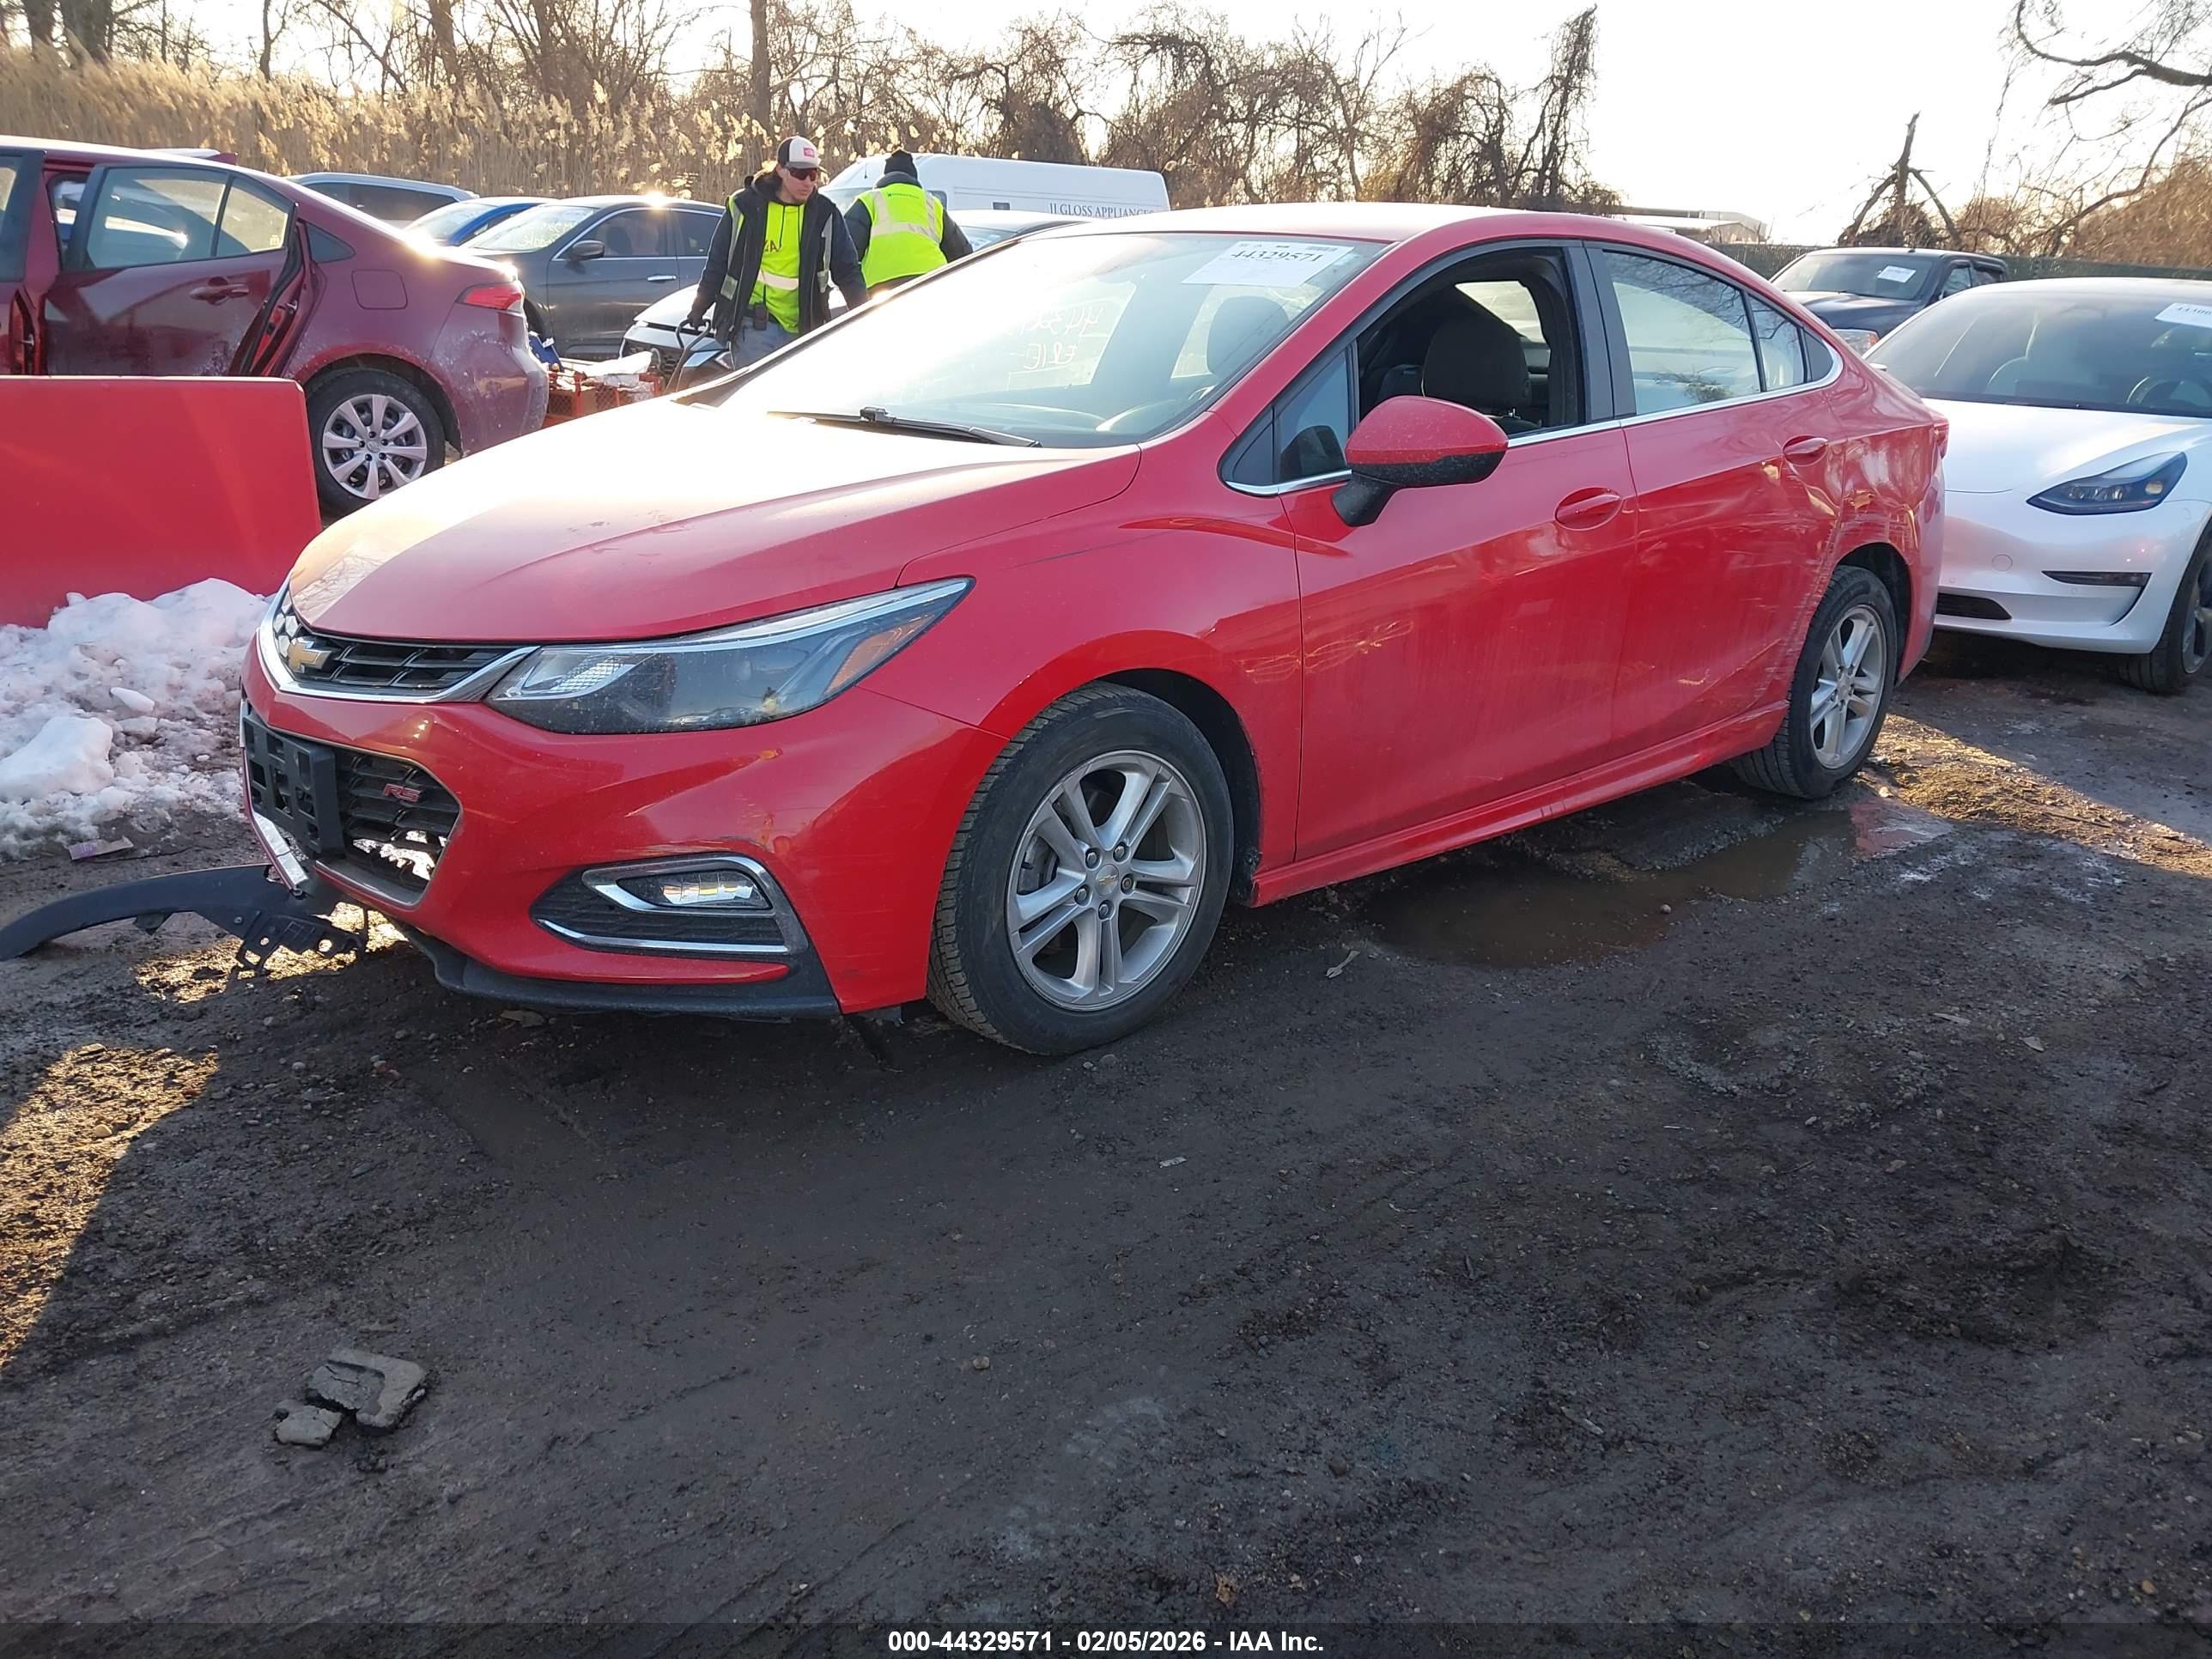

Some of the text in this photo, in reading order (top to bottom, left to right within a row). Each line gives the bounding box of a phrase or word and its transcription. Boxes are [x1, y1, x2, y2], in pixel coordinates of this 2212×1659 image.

[1060, 203, 1093, 217] GLOSS
[1231, 250, 1324, 262] 44329571
[384, 783, 422, 803] RS
